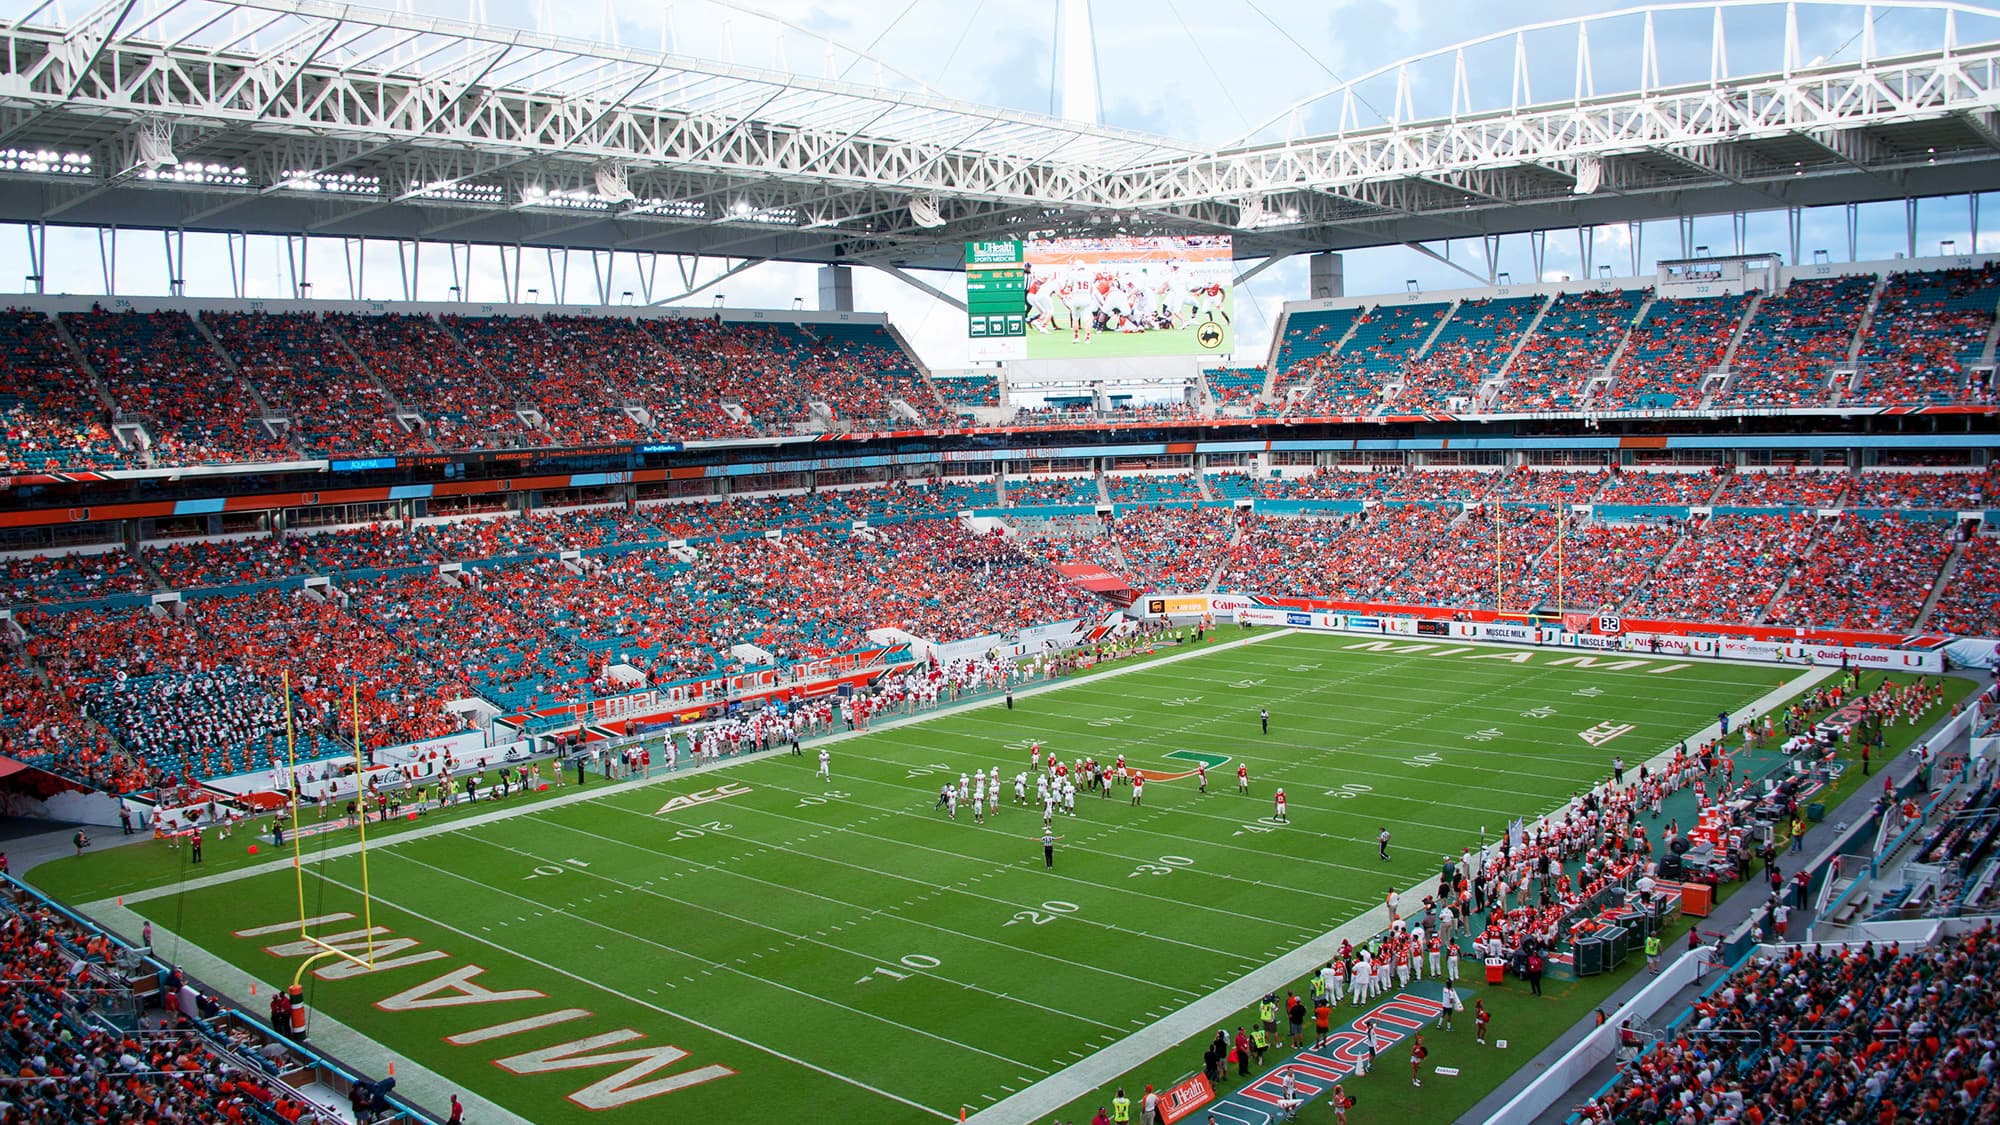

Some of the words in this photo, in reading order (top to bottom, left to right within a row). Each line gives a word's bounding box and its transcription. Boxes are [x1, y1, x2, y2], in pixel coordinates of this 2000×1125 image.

[69, 507, 90, 521] U
[1212, 599, 1249, 610] Canon
[1323, 617, 1338, 627] U
[1601, 619, 1618, 630] 32
[1461, 626, 1477, 636] U
[1486, 628, 1509, 637] MUSCLE
[1511, 628, 1526, 638] MILK
[1562, 635, 1573, 643] U
[1580, 638, 1605, 647] MUSCLE
[1015, 644, 1026, 656] U
[1694, 641, 1712, 652] U
[1786, 647, 1804, 658] U
[1341, 640, 1693, 674] MIAMI
[1858, 654, 1889, 663] Loans
[1903, 655, 1923, 667] U
[1578, 720, 1638, 747] ACC
[413, 762, 433, 778] U
[1324, 784, 1373, 799] 50
[655, 782, 752, 816] ACC
[675, 820, 734, 839] 20
[1242, 817, 1291, 833] 40
[533, 858, 591, 877] 10
[1135, 855, 1195, 876] 30
[1013, 900, 1080, 925] 20
[874, 953, 942, 983] 10
[232, 911, 740, 1110] MIAMI
[1160, 1078, 1205, 1114] UHealth
